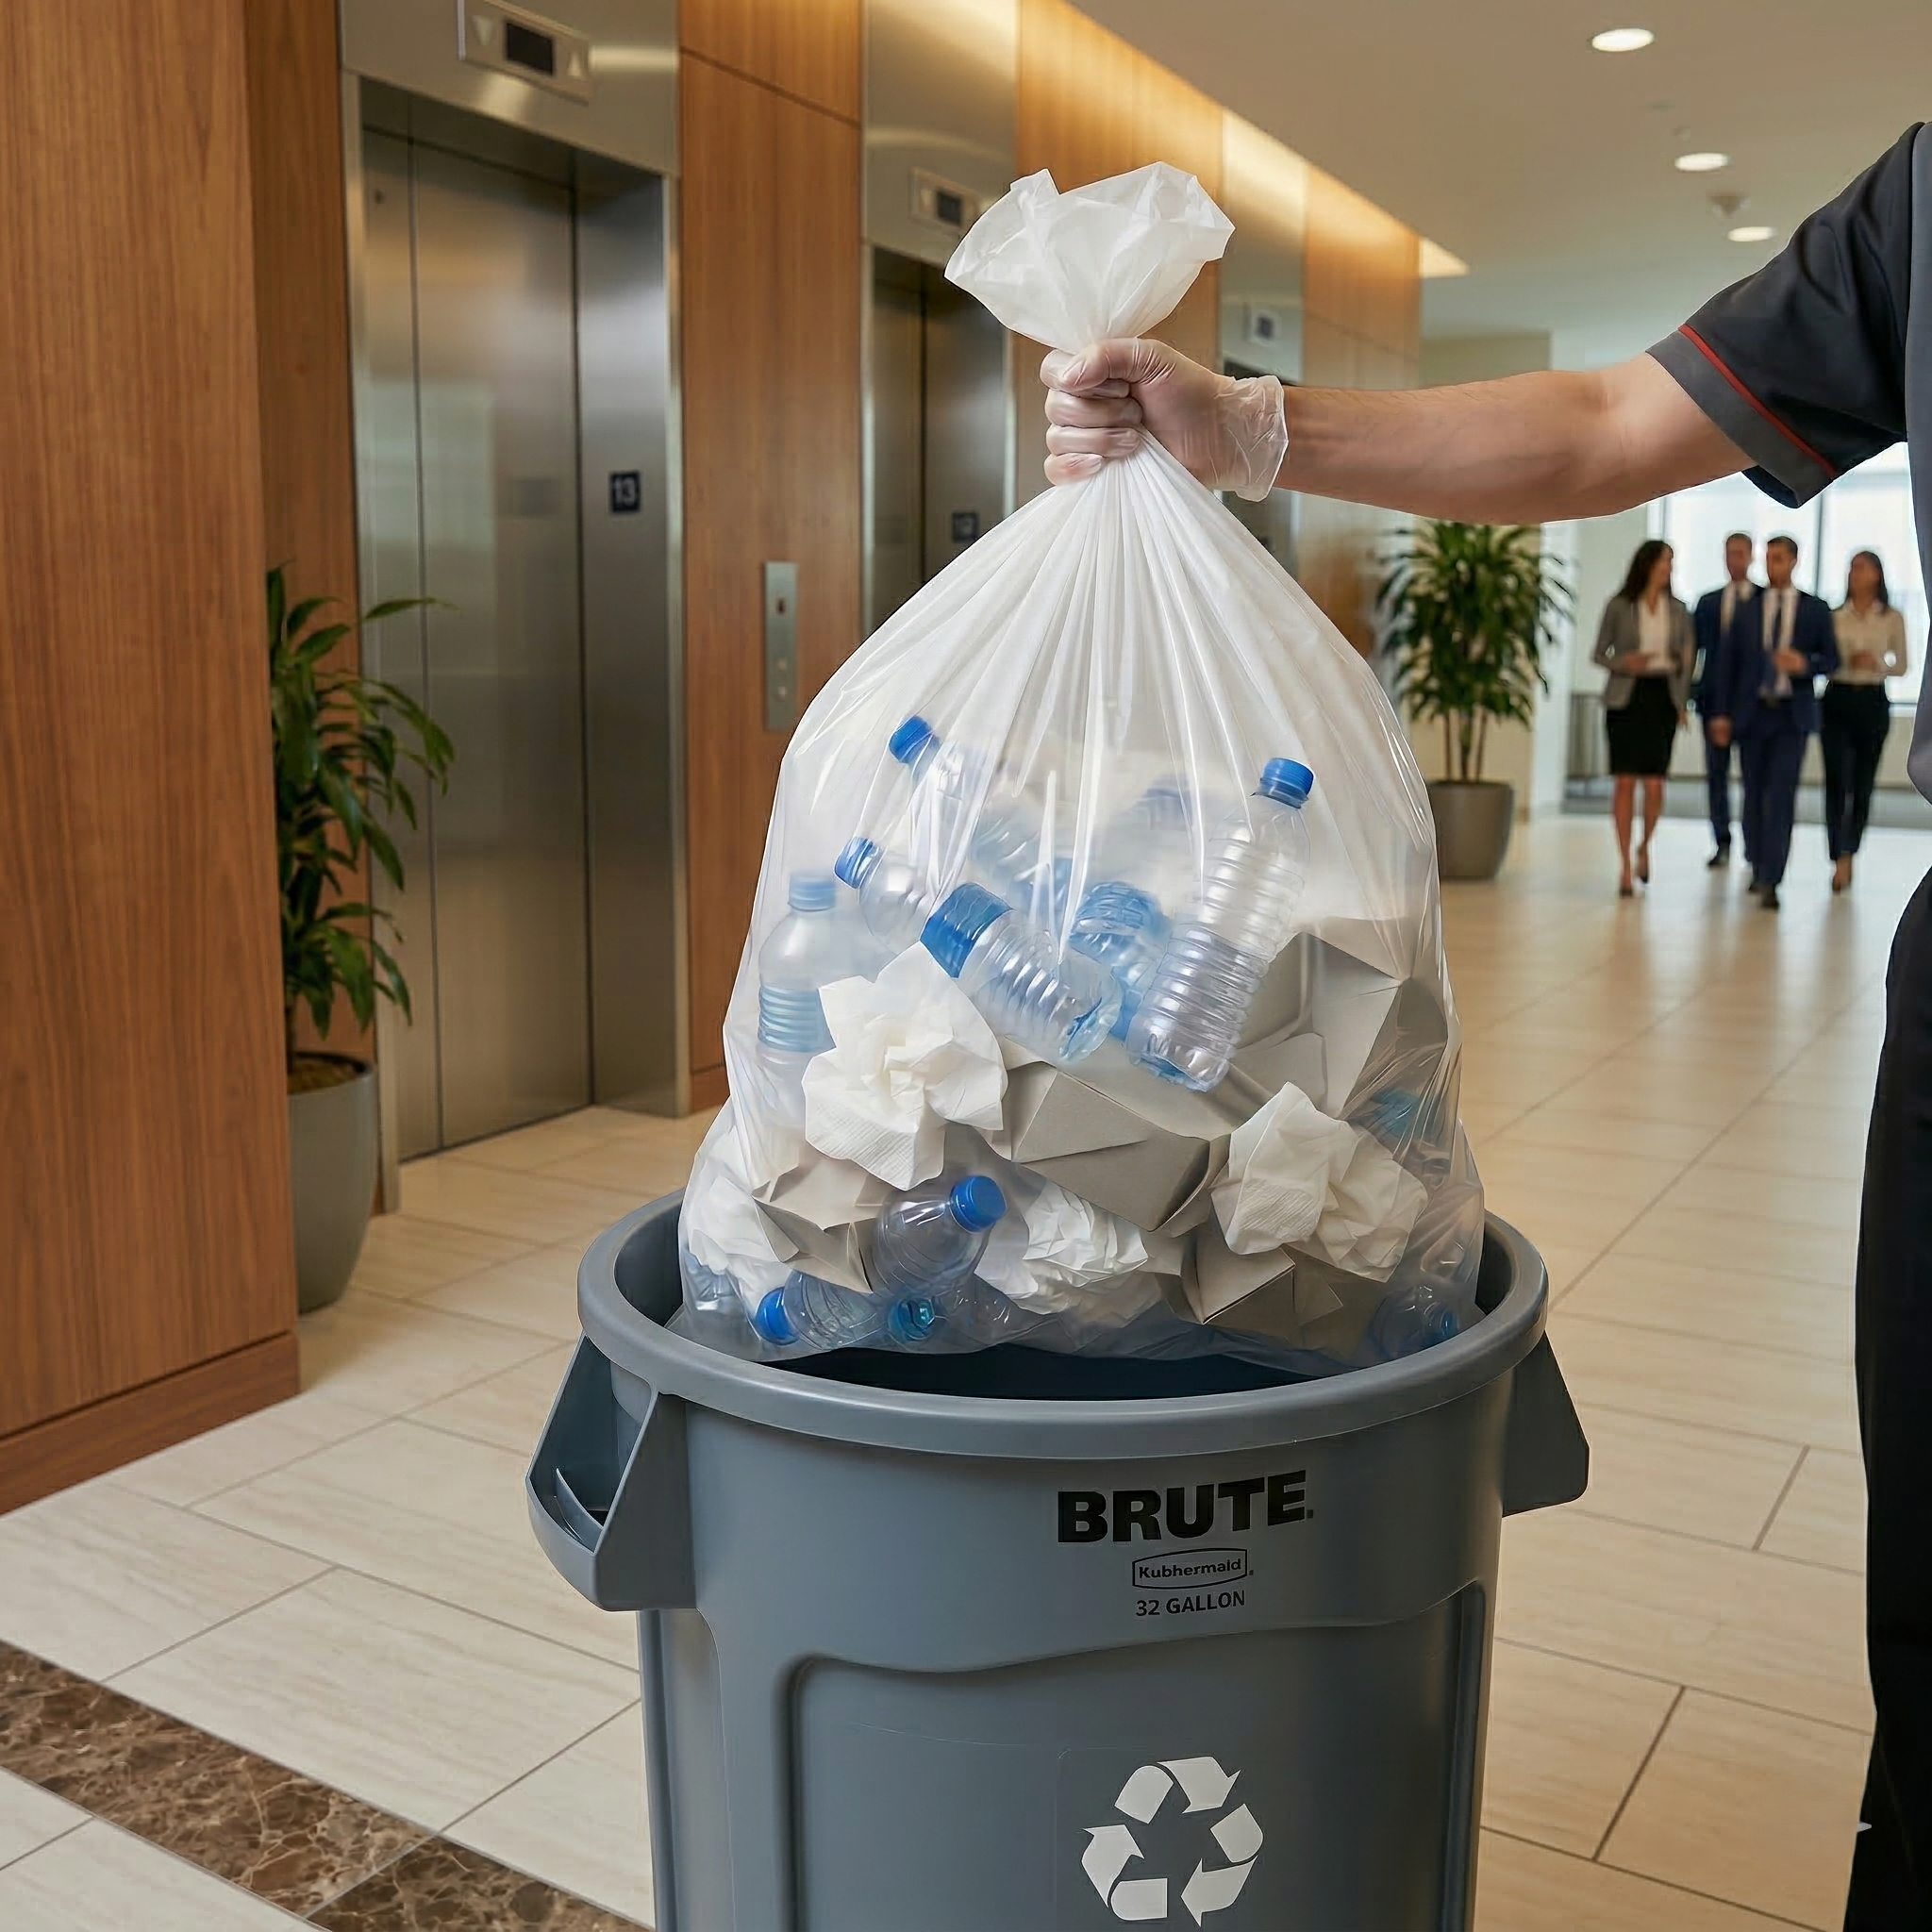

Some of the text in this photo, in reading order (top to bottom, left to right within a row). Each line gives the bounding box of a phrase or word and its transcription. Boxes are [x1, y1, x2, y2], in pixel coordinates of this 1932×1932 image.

[1058, 1469, 1307, 1543] BRUTE
[1135, 1590, 1245, 1617] 32 GALLON
